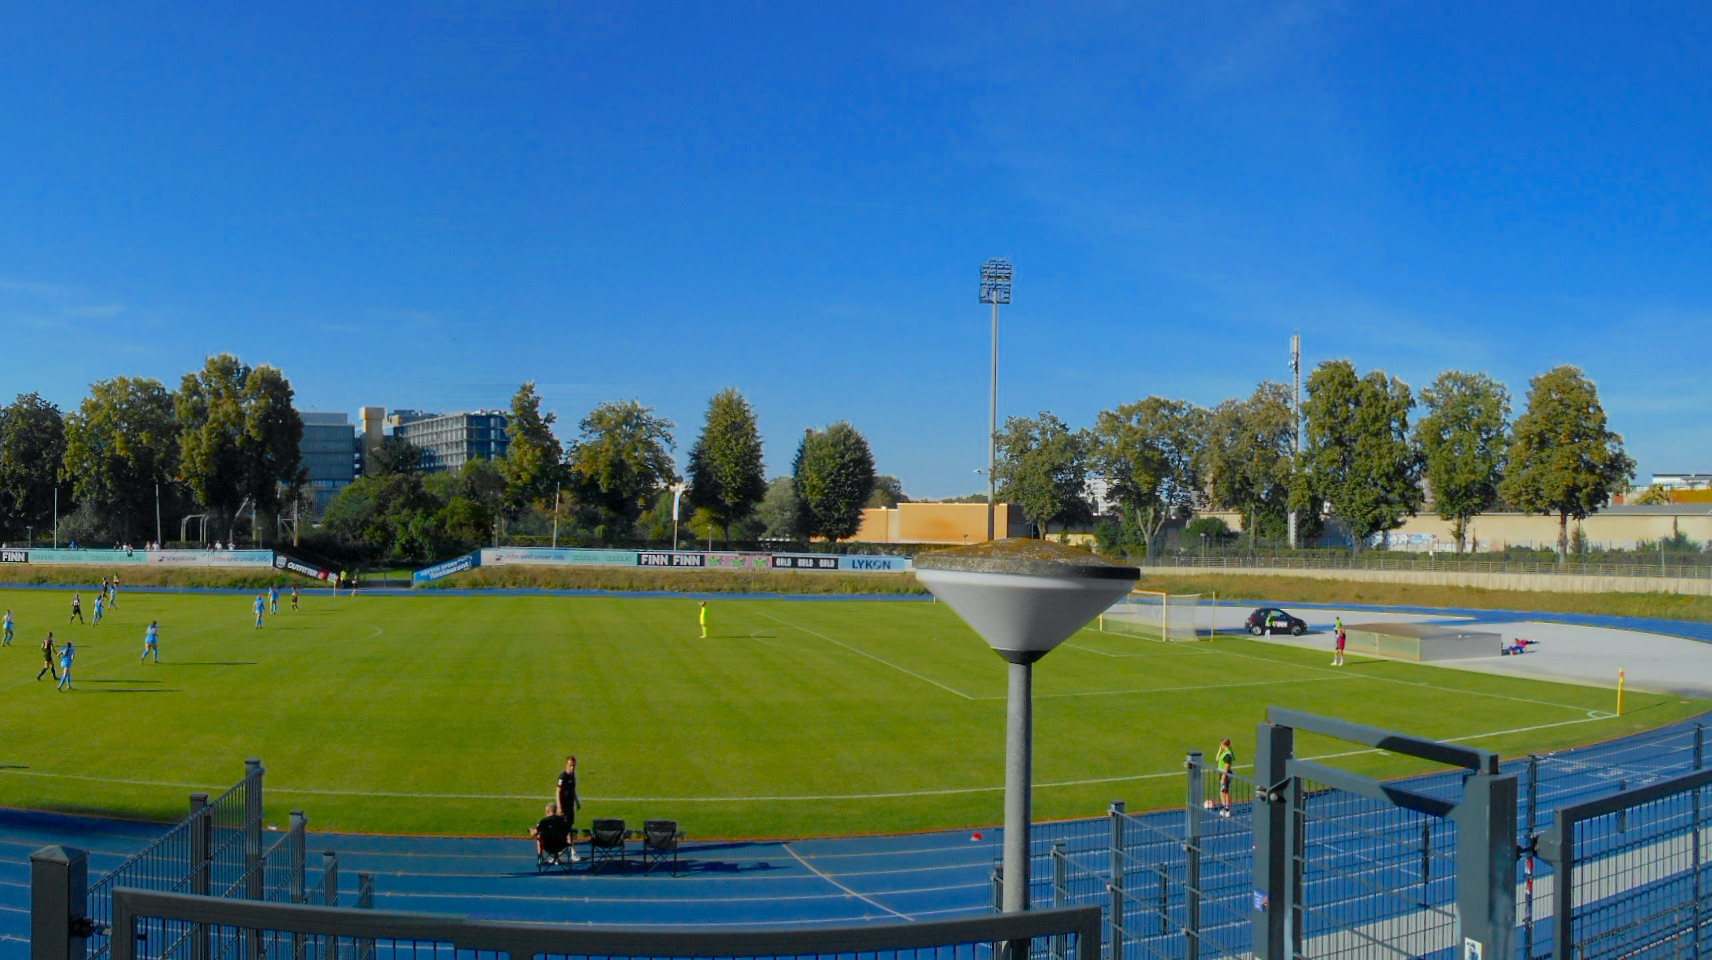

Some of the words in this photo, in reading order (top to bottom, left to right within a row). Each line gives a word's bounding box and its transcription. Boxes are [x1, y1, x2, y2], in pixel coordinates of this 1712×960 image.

[2, 552, 25, 562] FINN
[641, 554, 668, 565] FINN
[673, 555, 701, 566] FINN
[852, 559, 891, 569] LYKON
